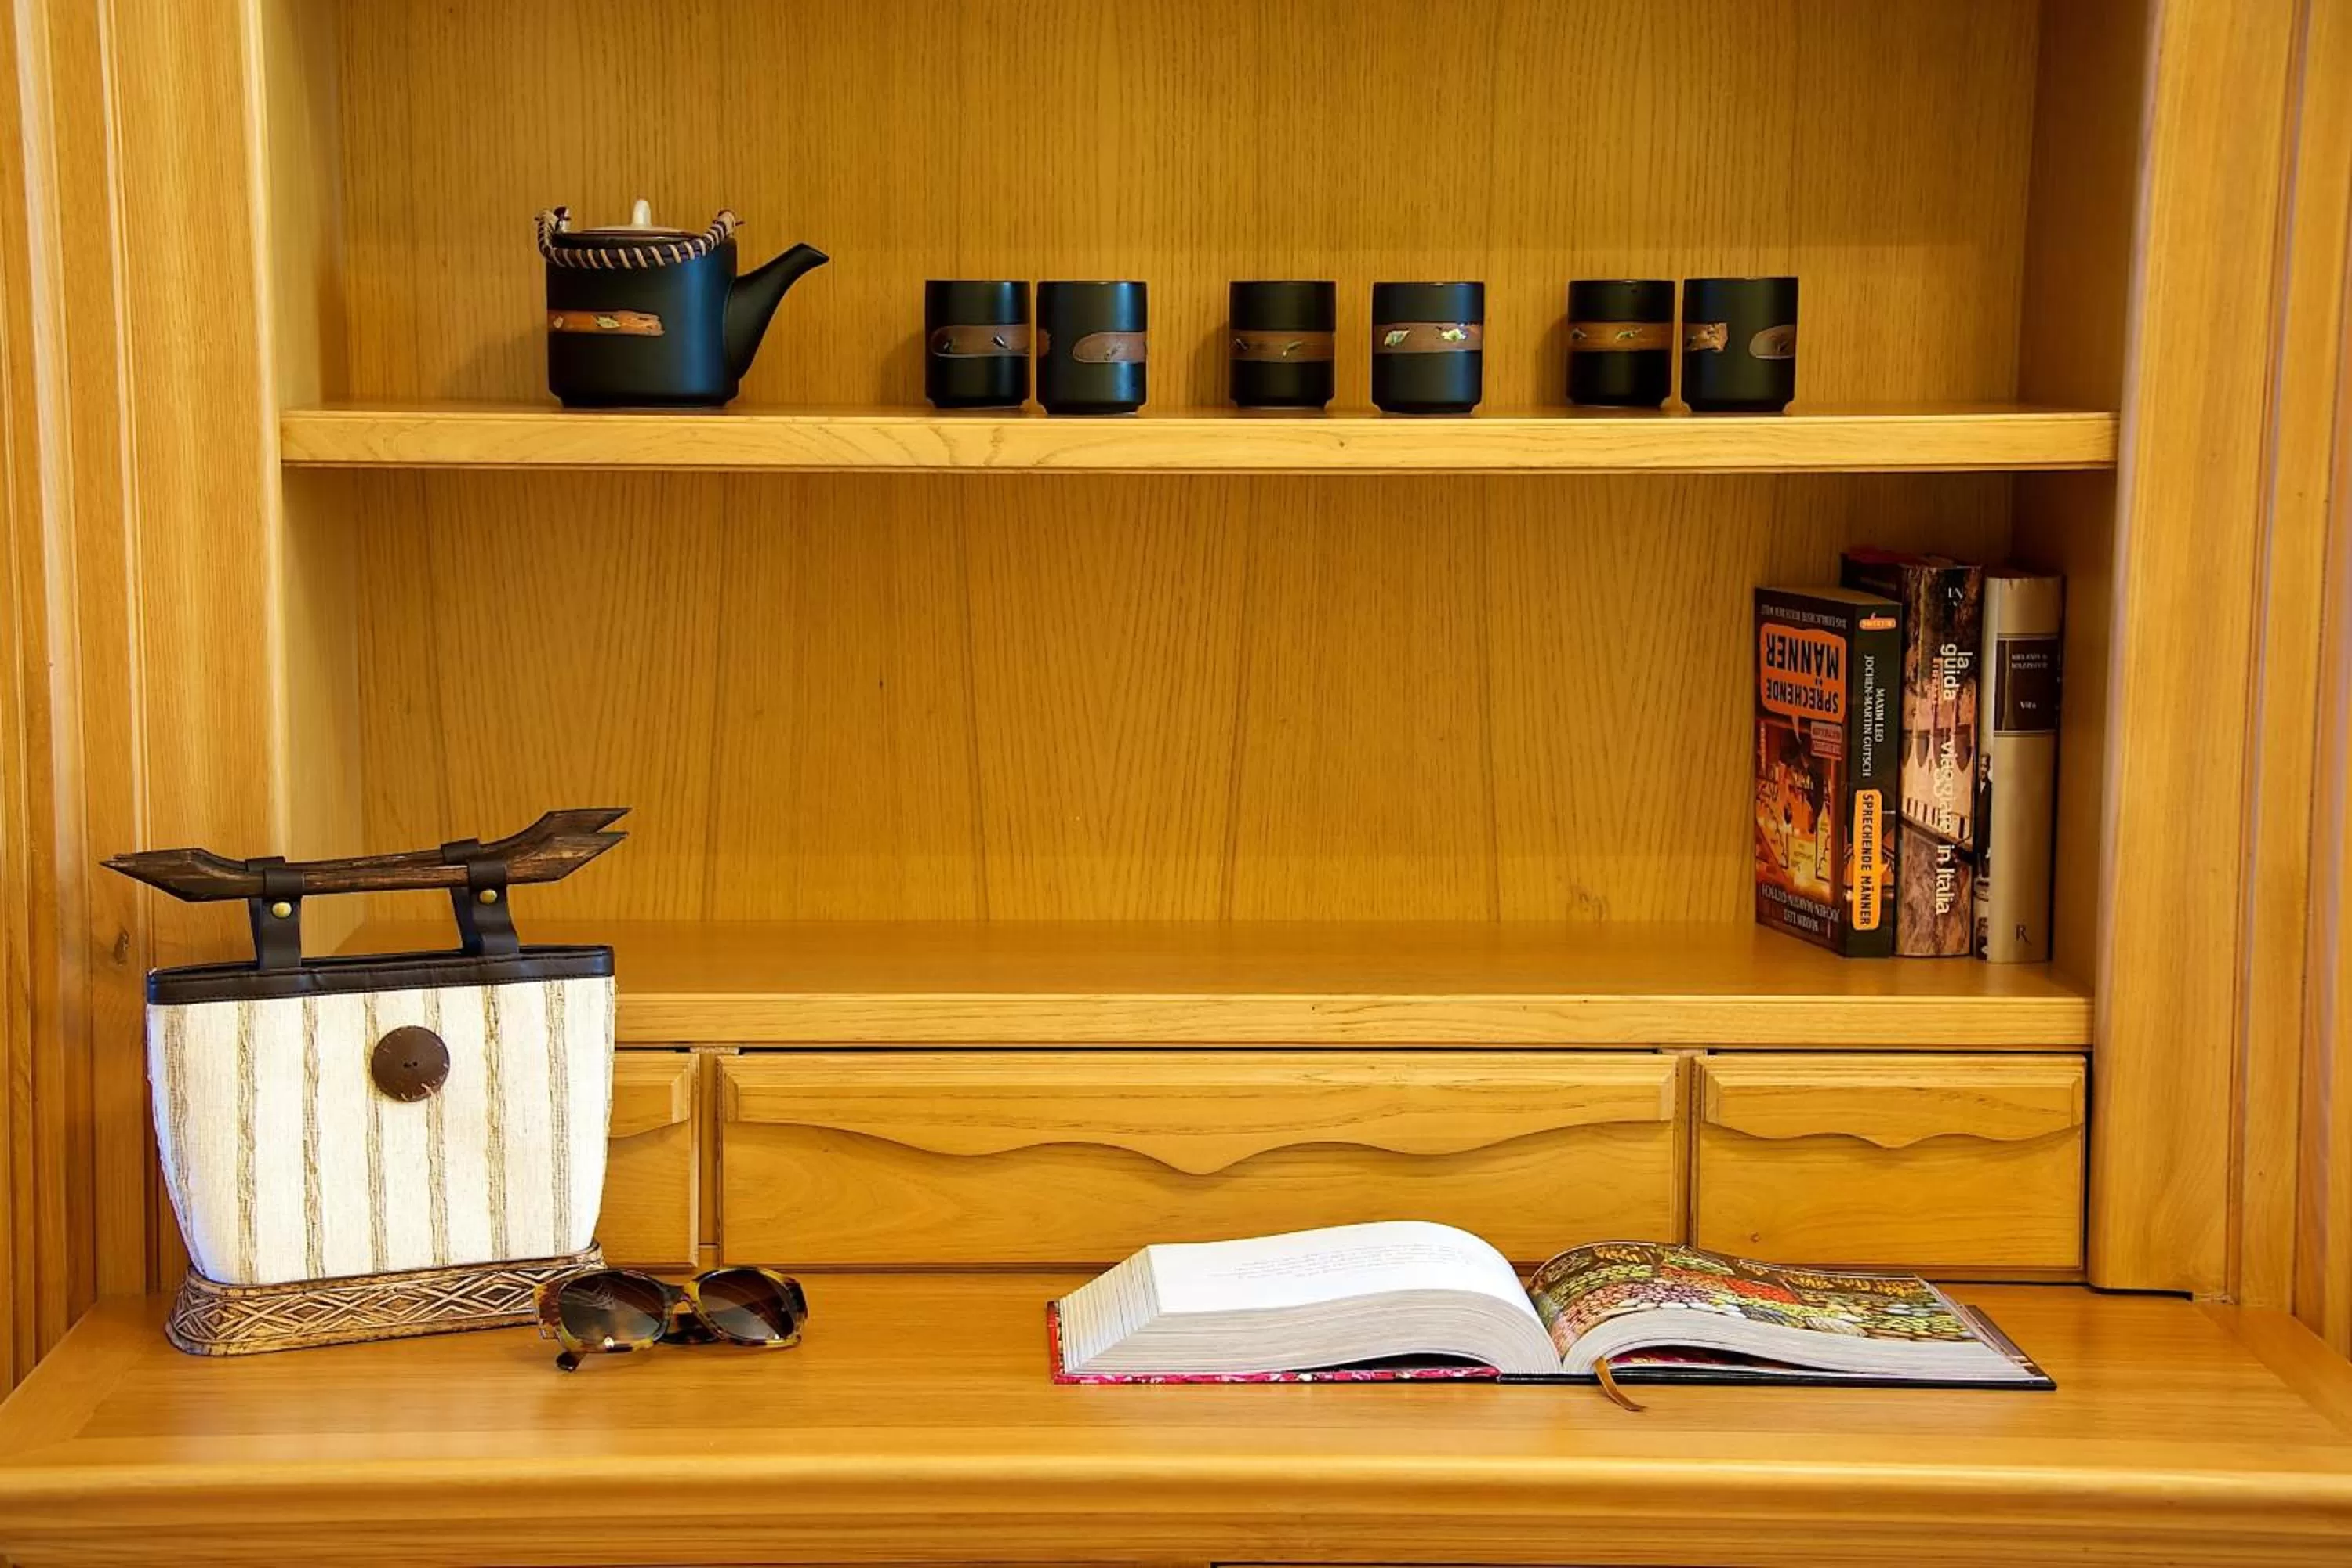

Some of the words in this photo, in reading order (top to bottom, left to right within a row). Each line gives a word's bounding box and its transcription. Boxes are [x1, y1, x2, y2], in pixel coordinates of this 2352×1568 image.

[1766, 633, 1840, 685] MÄNNER
[1940, 643, 1962, 701] guida
[1957, 652, 1973, 669] la
[1766, 678, 1839, 715] SPRECHENDE
[1862, 654, 1875, 735] JOCHEN-MARTIN
[1875, 688, 1886, 720] MAXIM
[1875, 723, 1885, 742] LEO
[1861, 735, 1874, 777] GUTSCH
[1933, 741, 1956, 833] viaggiare
[1860, 793, 1874, 871] SPRECHENDE
[1937, 844, 1955, 864] in
[1860, 875, 1875, 925] MÄNNER
[1936, 868, 1955, 916] Italia
[2016, 924, 2033, 946] R
